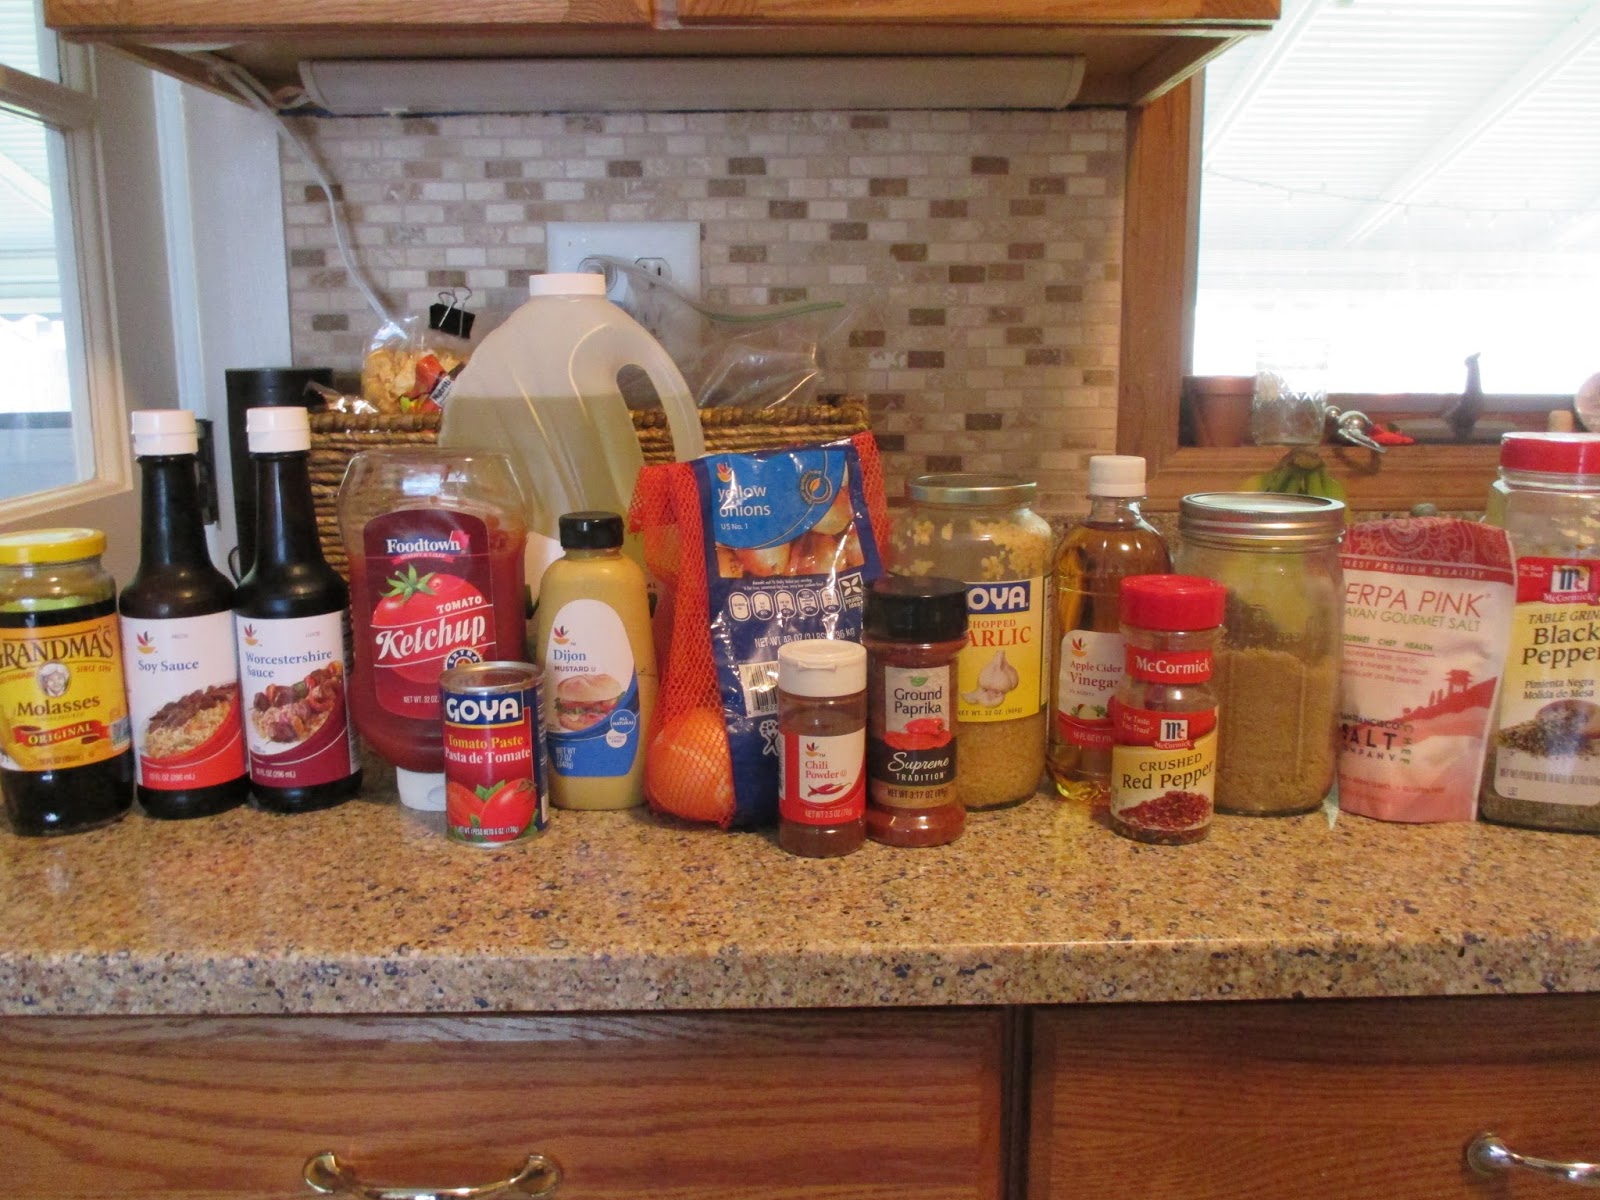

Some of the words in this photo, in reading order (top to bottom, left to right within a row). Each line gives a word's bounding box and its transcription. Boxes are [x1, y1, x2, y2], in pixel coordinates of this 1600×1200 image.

[718, 484, 767, 502] yellow
[719, 500, 771, 518] onions
[386, 538, 461, 553] Foodtown
[1375, 562, 1426, 575] PREMIUM
[1433, 567, 1485, 578] QUALITY
[436, 595, 482, 614] TOMATO
[967, 585, 1026, 610] OYA
[1345, 582, 1408, 610] ERPA
[1418, 590, 1481, 618] PINK
[971, 619, 1016, 629] HOPPED
[1381, 611, 1446, 628] GOURMET
[1448, 617, 1480, 632] SALT
[1529, 612, 1567, 625] TABLE
[1570, 609, 1600, 621] GRIN
[376, 615, 486, 660] Ketchup
[967, 626, 1032, 647] ARLIC
[1533, 622, 1600, 646] Black
[245, 650, 332, 665] Worcestershire
[448, 648, 480, 664] EXTRA
[553, 649, 587, 663] Dijon
[138, 659, 158, 675] Soy
[161, 660, 199, 672] Sauce
[247, 665, 275, 678] Sauce
[1070, 660, 1094, 673] Apple
[1096, 662, 1123, 673] Cider
[1136, 655, 1210, 675] McCormick
[1525, 680, 1564, 689] Pimienta
[1567, 679, 1594, 689] Negra
[403, 696, 413, 704] NET
[894, 686, 942, 701] Ground
[1523, 690, 1553, 700] Molida
[1556, 690, 1568, 698] de
[1570, 689, 1594, 698] Mesa
[17, 695, 101, 717] Molasses
[446, 697, 519, 722] GOYA
[894, 701, 942, 718] Paprika
[28, 723, 93, 745] ORIGINAL
[449, 733, 488, 749] Tomato
[491, 734, 524, 748] Paste
[1154, 741, 1192, 749] McCormick
[445, 747, 467, 764] Pasta
[469, 752, 483, 764] de
[485, 748, 531, 764] Tomate
[1351, 746, 1395, 761] MPANY
[805, 760, 828, 770] Chili
[888, 752, 949, 774] Supreme
[1139, 752, 1202, 772] CRUSHED
[805, 770, 839, 779] Powder
[896, 772, 944, 782] TRADITION
[1122, 774, 1152, 789] Red
[1160, 759, 1213, 790] Pepper
[925, 790, 934, 798] OZ
